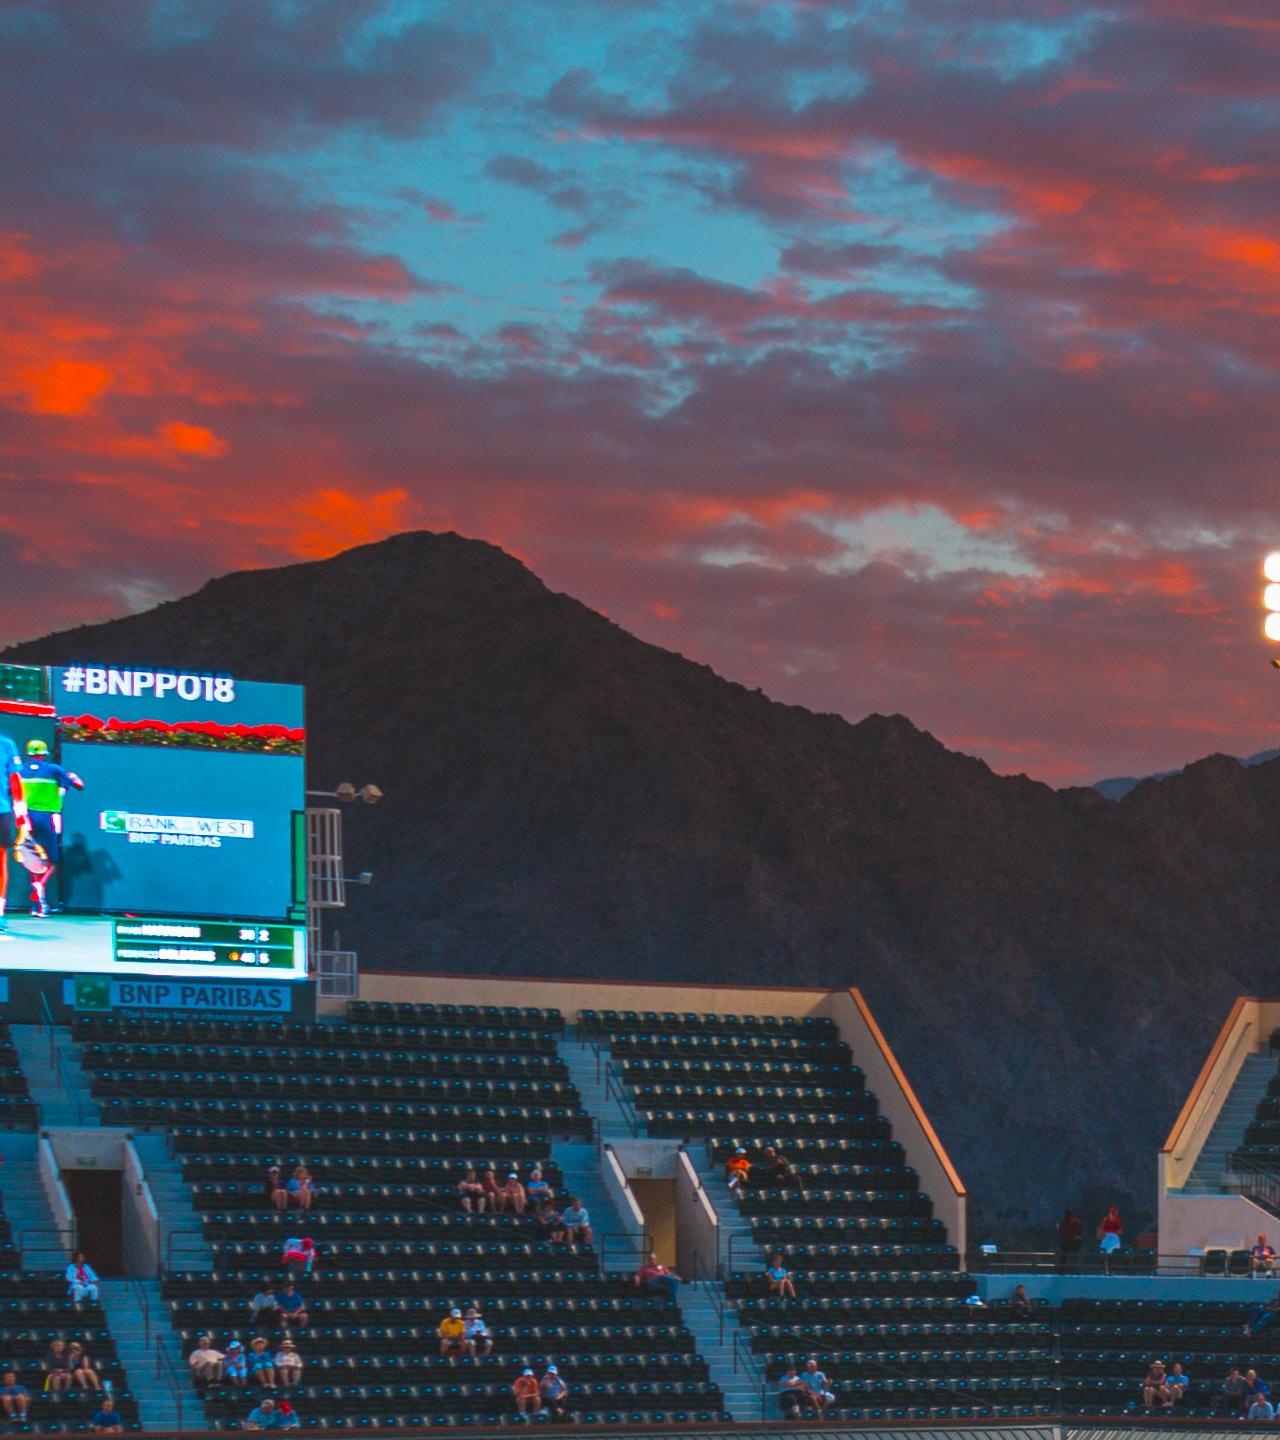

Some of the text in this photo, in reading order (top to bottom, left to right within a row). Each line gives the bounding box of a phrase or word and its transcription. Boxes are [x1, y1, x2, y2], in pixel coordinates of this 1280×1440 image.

[62, 667, 235, 702] #BNPPO18
[129, 815, 177, 831] BANK
[199, 820, 248, 835] WEST
[119, 984, 283, 1008] BNP PARIBAS
